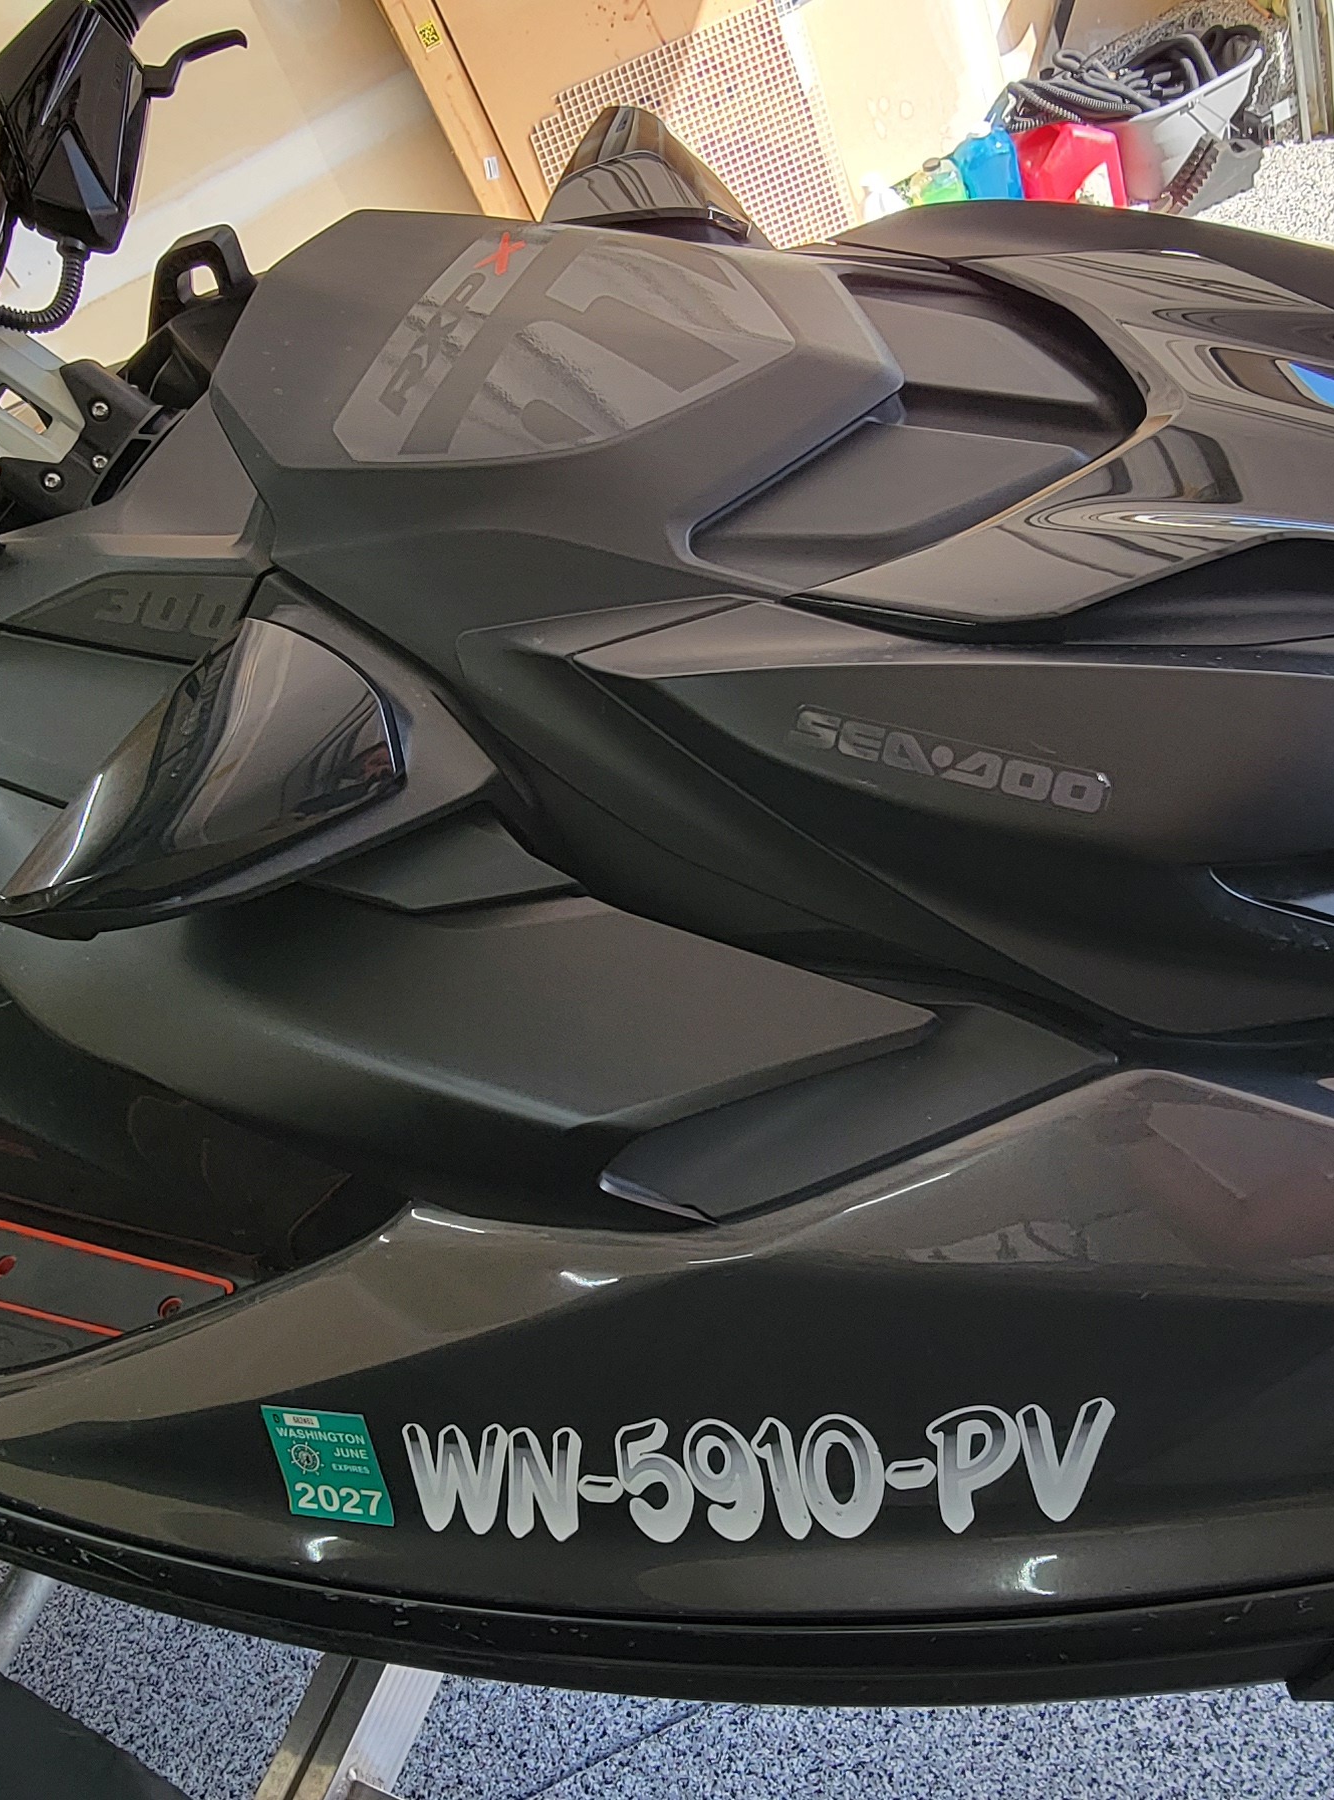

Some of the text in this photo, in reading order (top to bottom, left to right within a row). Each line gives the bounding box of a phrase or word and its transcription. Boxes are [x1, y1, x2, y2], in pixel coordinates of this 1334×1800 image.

[275, 1427, 366, 1445] WASHINGTON
[334, 1447, 369, 1460] JUNE
[331, 1463, 370, 1475] EXPIRES
[402, 1397, 1116, 1543] WN-5910-PV
[294, 1482, 383, 1516] 2027
